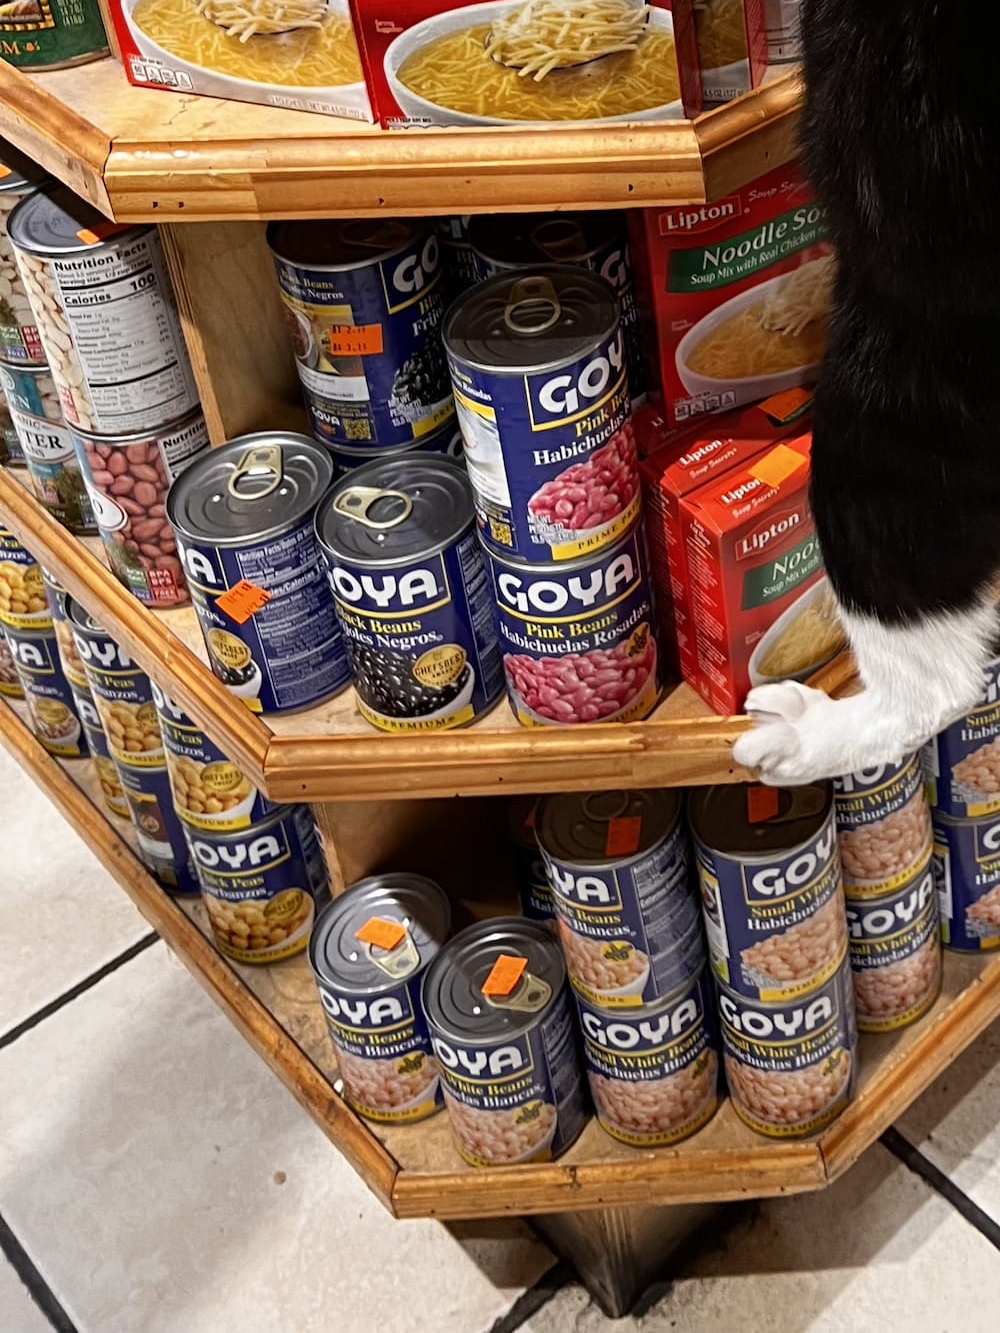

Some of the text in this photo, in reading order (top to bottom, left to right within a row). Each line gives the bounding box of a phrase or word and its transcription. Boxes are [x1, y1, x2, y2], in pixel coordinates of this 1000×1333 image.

[666, 202, 734, 230] Lipton
[54, 242, 147, 272] Nutrition Facts
[702, 220, 789, 271] Noodle
[690, 230, 817, 286] Soup Mix with Real Chicken
[130, 273, 156, 291] 100
[64, 292, 111, 306] Calories
[538, 336, 624, 414] GOY
[575, 413, 609, 436] Pink
[680, 438, 723, 467] Lipton
[741, 511, 801, 555] Lipton
[498, 553, 634, 612] GOYA
[762, 570, 800, 598] Soup Mix
[371, 617, 422, 633] Beans
[526, 610, 618, 639] Pink Beans
[594, 604, 646, 642] Rosadas
[377, 630, 437, 652] Negros
[231, 874, 266, 888] Peas
[577, 912, 622, 926] Beans
[751, 902, 796, 919] Small
[582, 998, 700, 1049] GOYA
[719, 993, 833, 1037] GOYA
[371, 1025, 414, 1044] Beans
[363, 1038, 421, 1058] Blancas
[753, 1047, 797, 1062] White
[619, 1053, 666, 1068] White
[491, 1076, 534, 1094] Beans
[482, 1088, 541, 1109] Blancas
